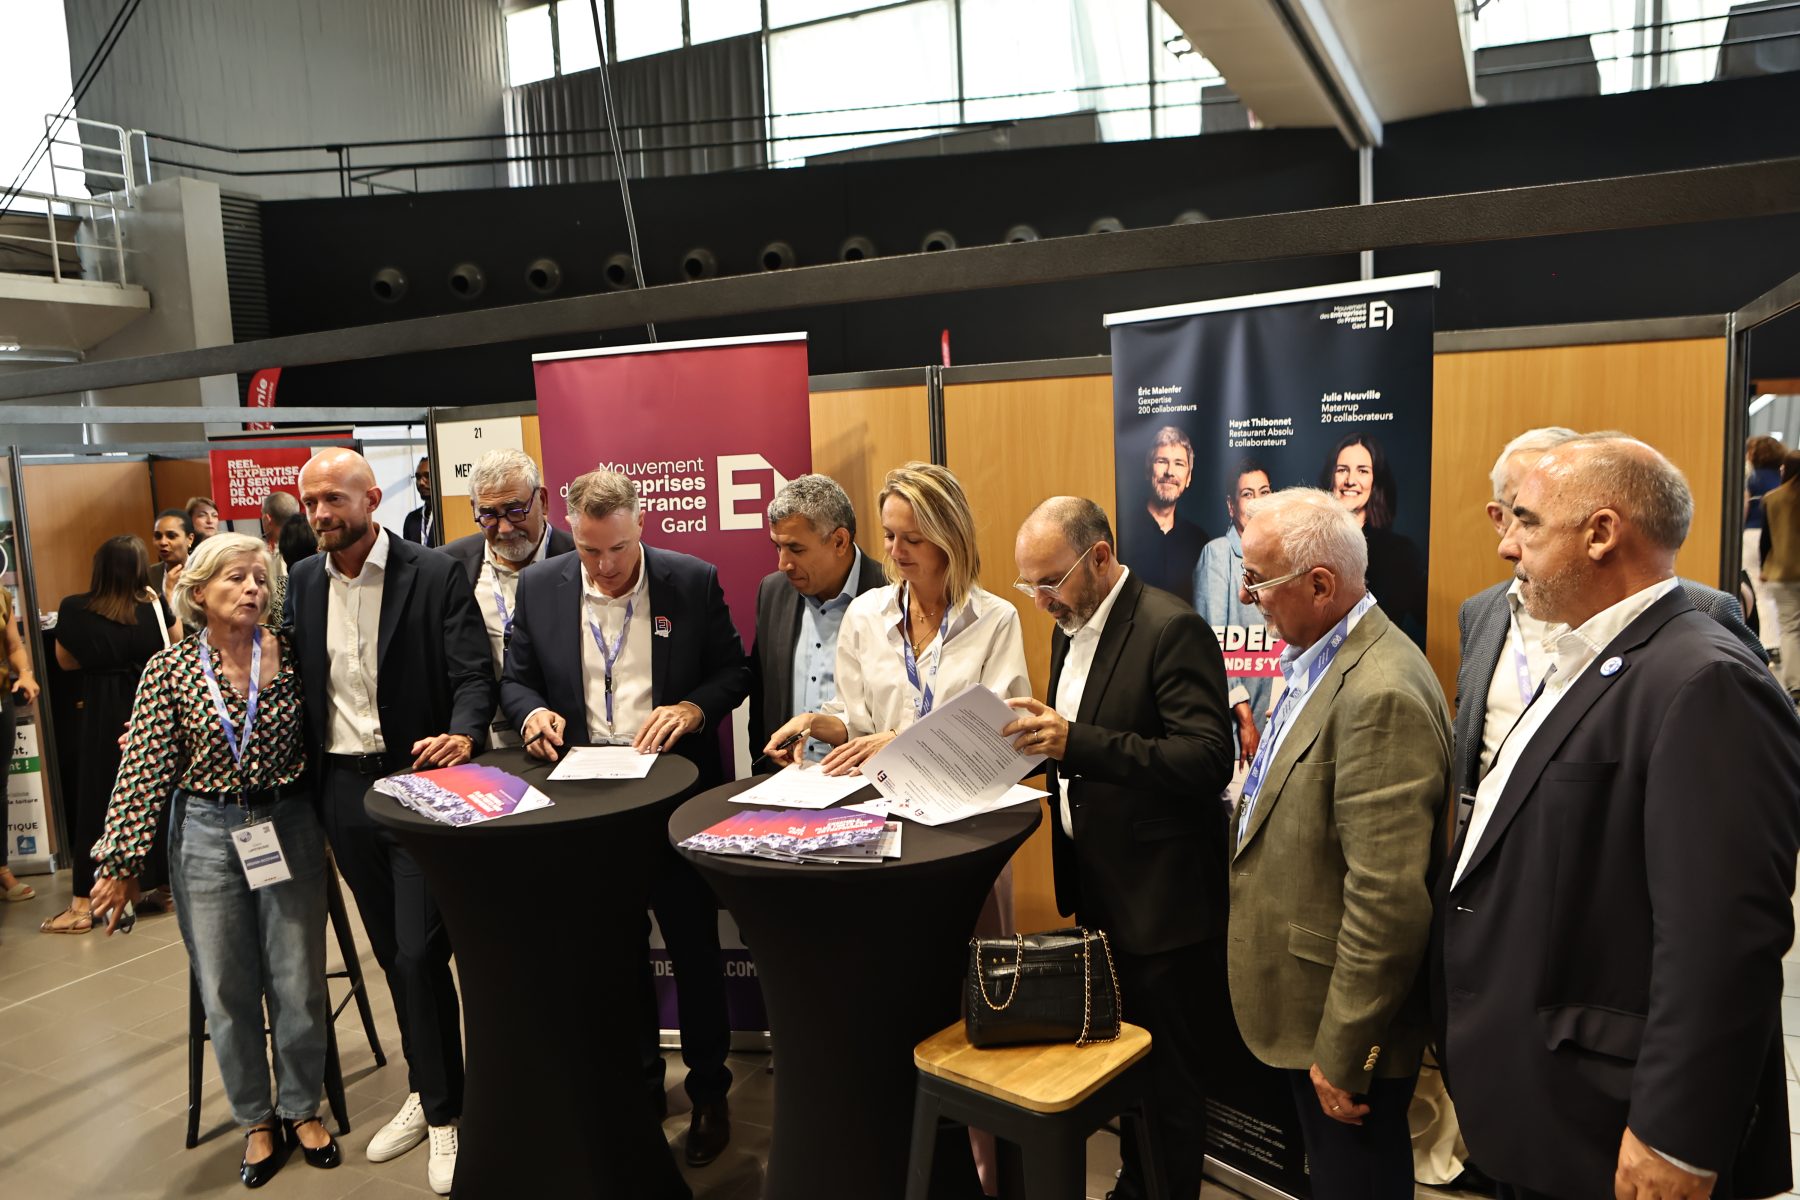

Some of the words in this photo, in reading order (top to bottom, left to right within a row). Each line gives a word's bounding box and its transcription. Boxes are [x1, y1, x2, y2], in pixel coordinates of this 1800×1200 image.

[1138, 386, 1151, 396] Éric
[1152, 385, 1182, 395] Malenfer
[1321, 392, 1342, 402] Julie
[1344, 390, 1381, 401] Neuville
[1138, 396, 1172, 406] Gexpertise
[1138, 406, 1150, 414] 200
[1152, 404, 1197, 413] collaborateurs
[1321, 403, 1359, 415] Materrup
[1229, 419, 1250, 430] Hayat
[1251, 417, 1292, 427] Thibonnet
[1321, 414, 1331, 423] 20
[1333, 412, 1393, 422] collaborateurs
[474, 427, 482, 439] 21
[1229, 429, 1266, 438] Restaurant
[1268, 427, 1294, 436] Absolu
[1229, 439, 1234, 447] 8
[1235, 437, 1286, 447] collaborateurs
[599, 457, 705, 476] Mouvement
[230, 479, 244, 488] AU
[247, 476, 295, 487] SERVICE
[632, 474, 706, 496] eprises
[230, 488, 245, 497] DE
[247, 487, 270, 496] VOS
[661, 516, 707, 534] Gard
[1225, 658, 1252, 671] NDE
[8, 822, 39, 832] TIQUE
